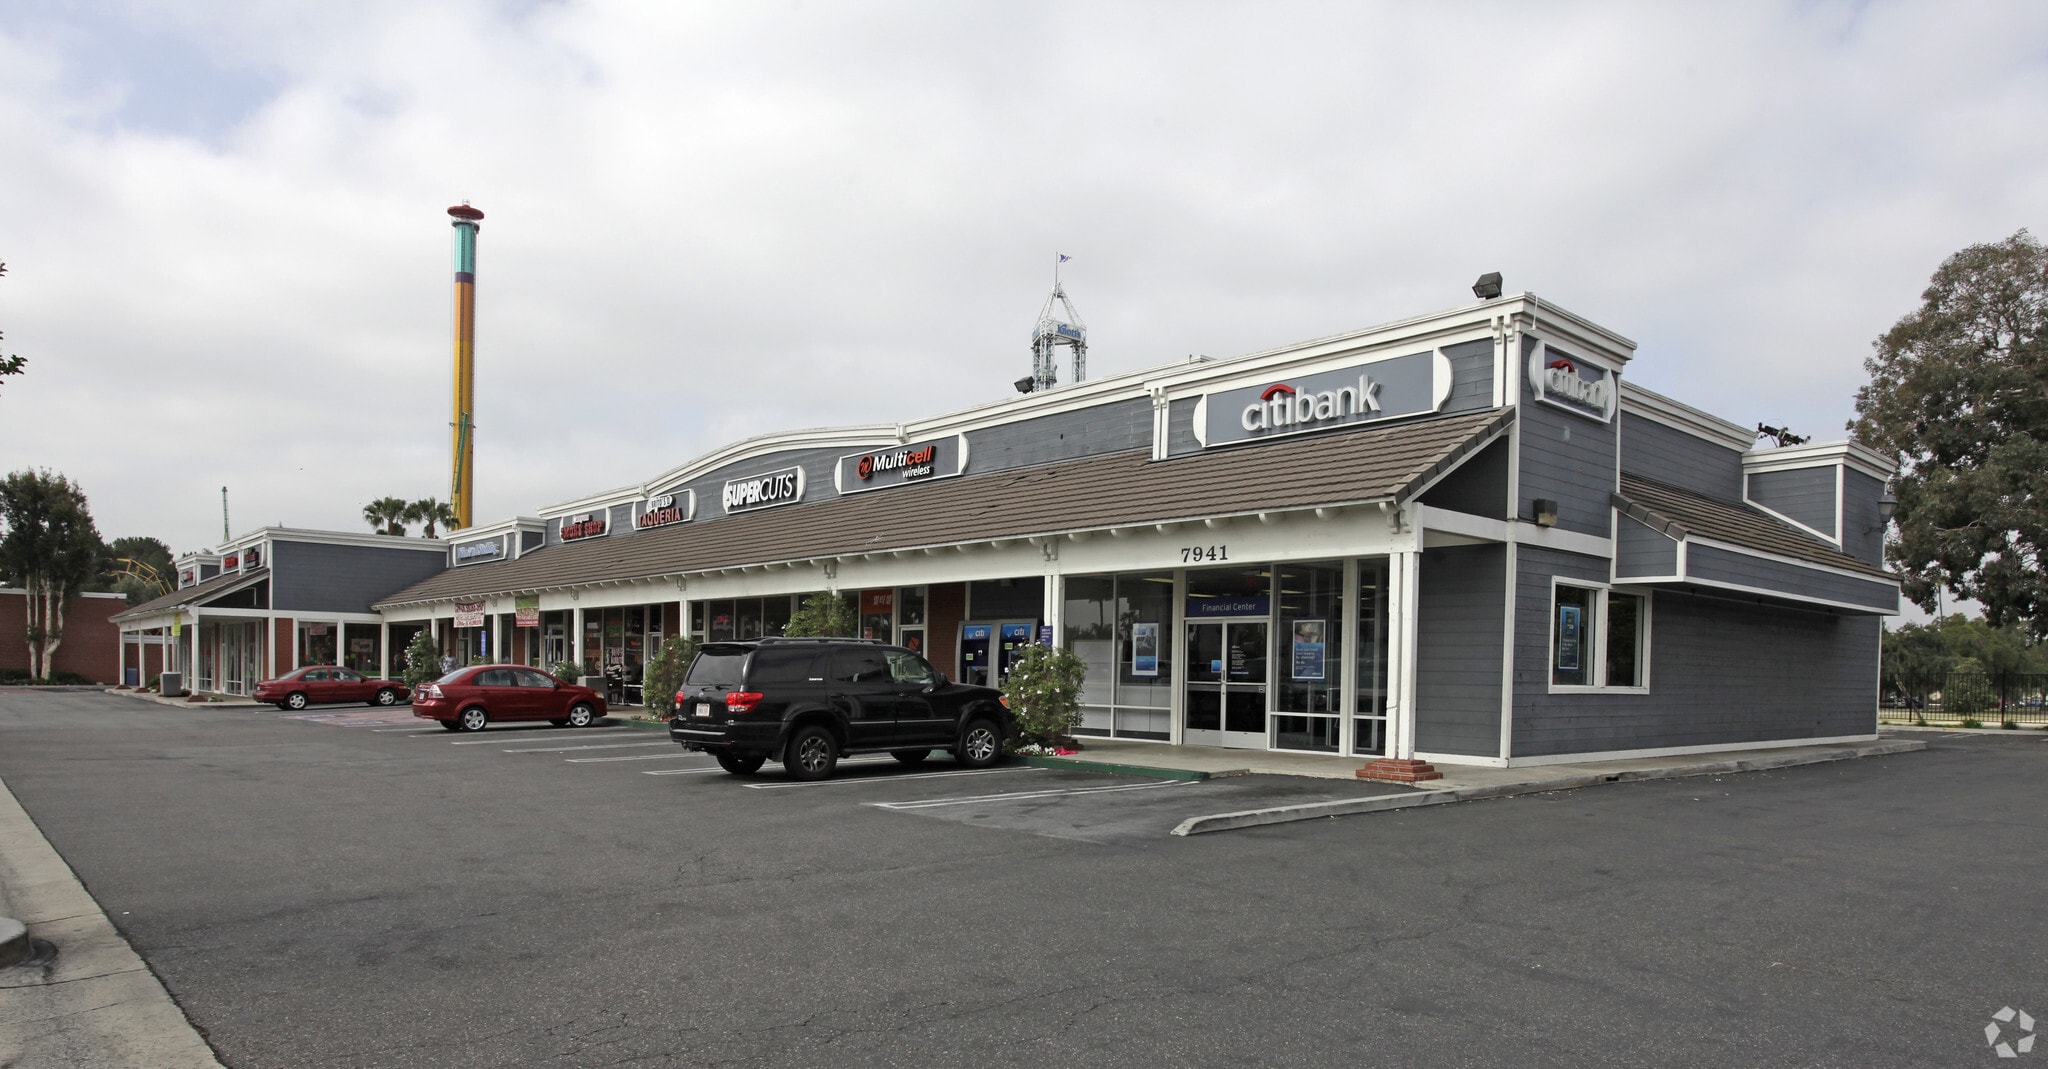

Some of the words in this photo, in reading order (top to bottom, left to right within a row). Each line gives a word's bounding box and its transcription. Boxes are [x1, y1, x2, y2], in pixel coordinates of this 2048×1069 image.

[1241, 374, 1381, 431] citibank
[872, 446, 934, 472] Multicell
[902, 465, 931, 479] wireless
[726, 473, 794, 507] SUPERCUTS
[638, 507, 681, 527] TAQUERIA
[584, 520, 603, 534] SHOP
[1181, 544, 1229, 563] 7941
[1202, 604, 1232, 612] Financial
[1232, 602, 1256, 611] Center
